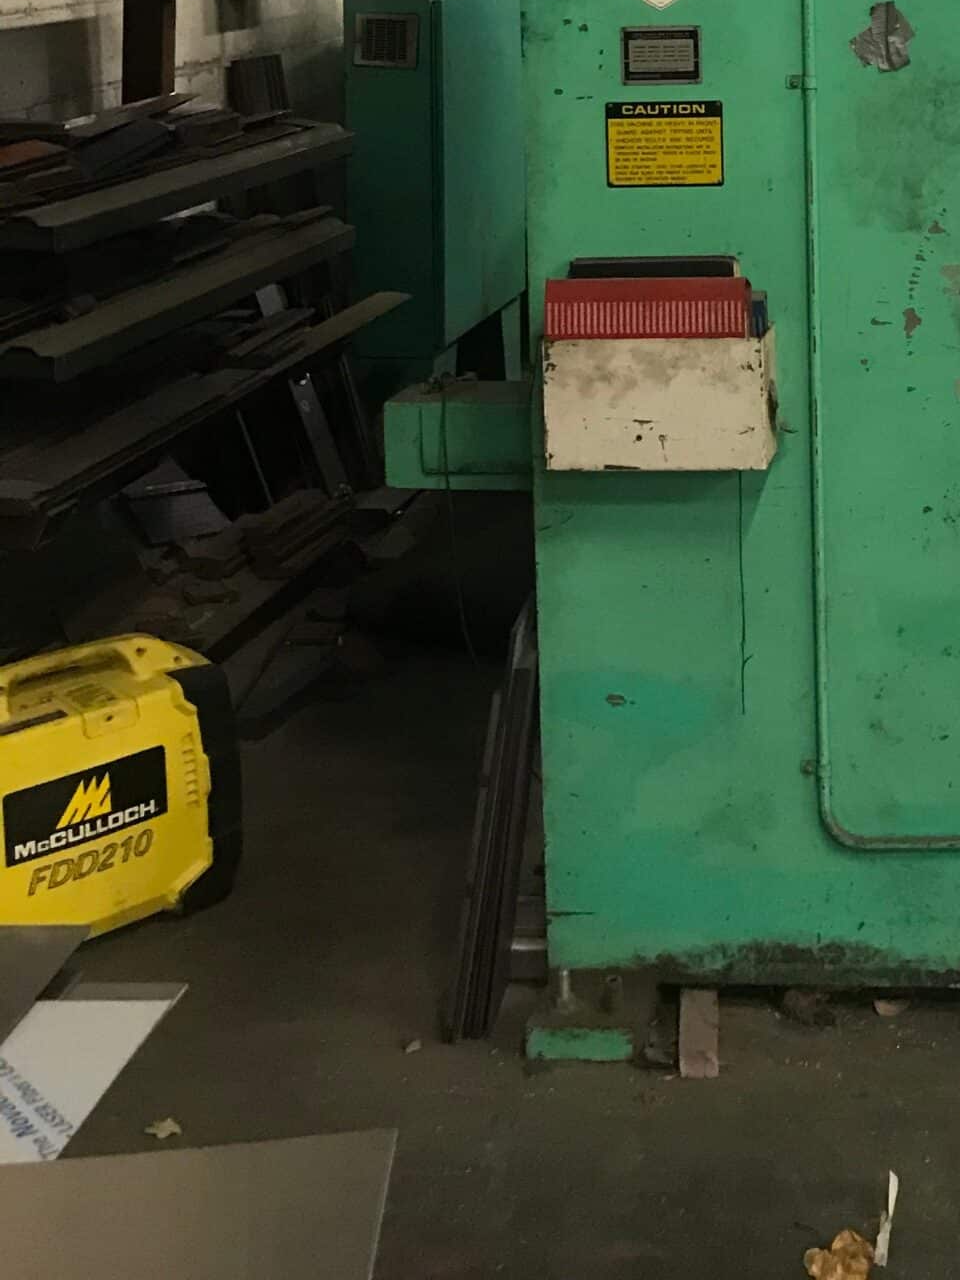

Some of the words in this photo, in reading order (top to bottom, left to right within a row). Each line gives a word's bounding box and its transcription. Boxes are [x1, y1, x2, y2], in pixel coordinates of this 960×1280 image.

[621, 103, 706, 115] CAUTION
[13, 799, 157, 860] McCULLOCH
[27, 827, 154, 897] FDD210
